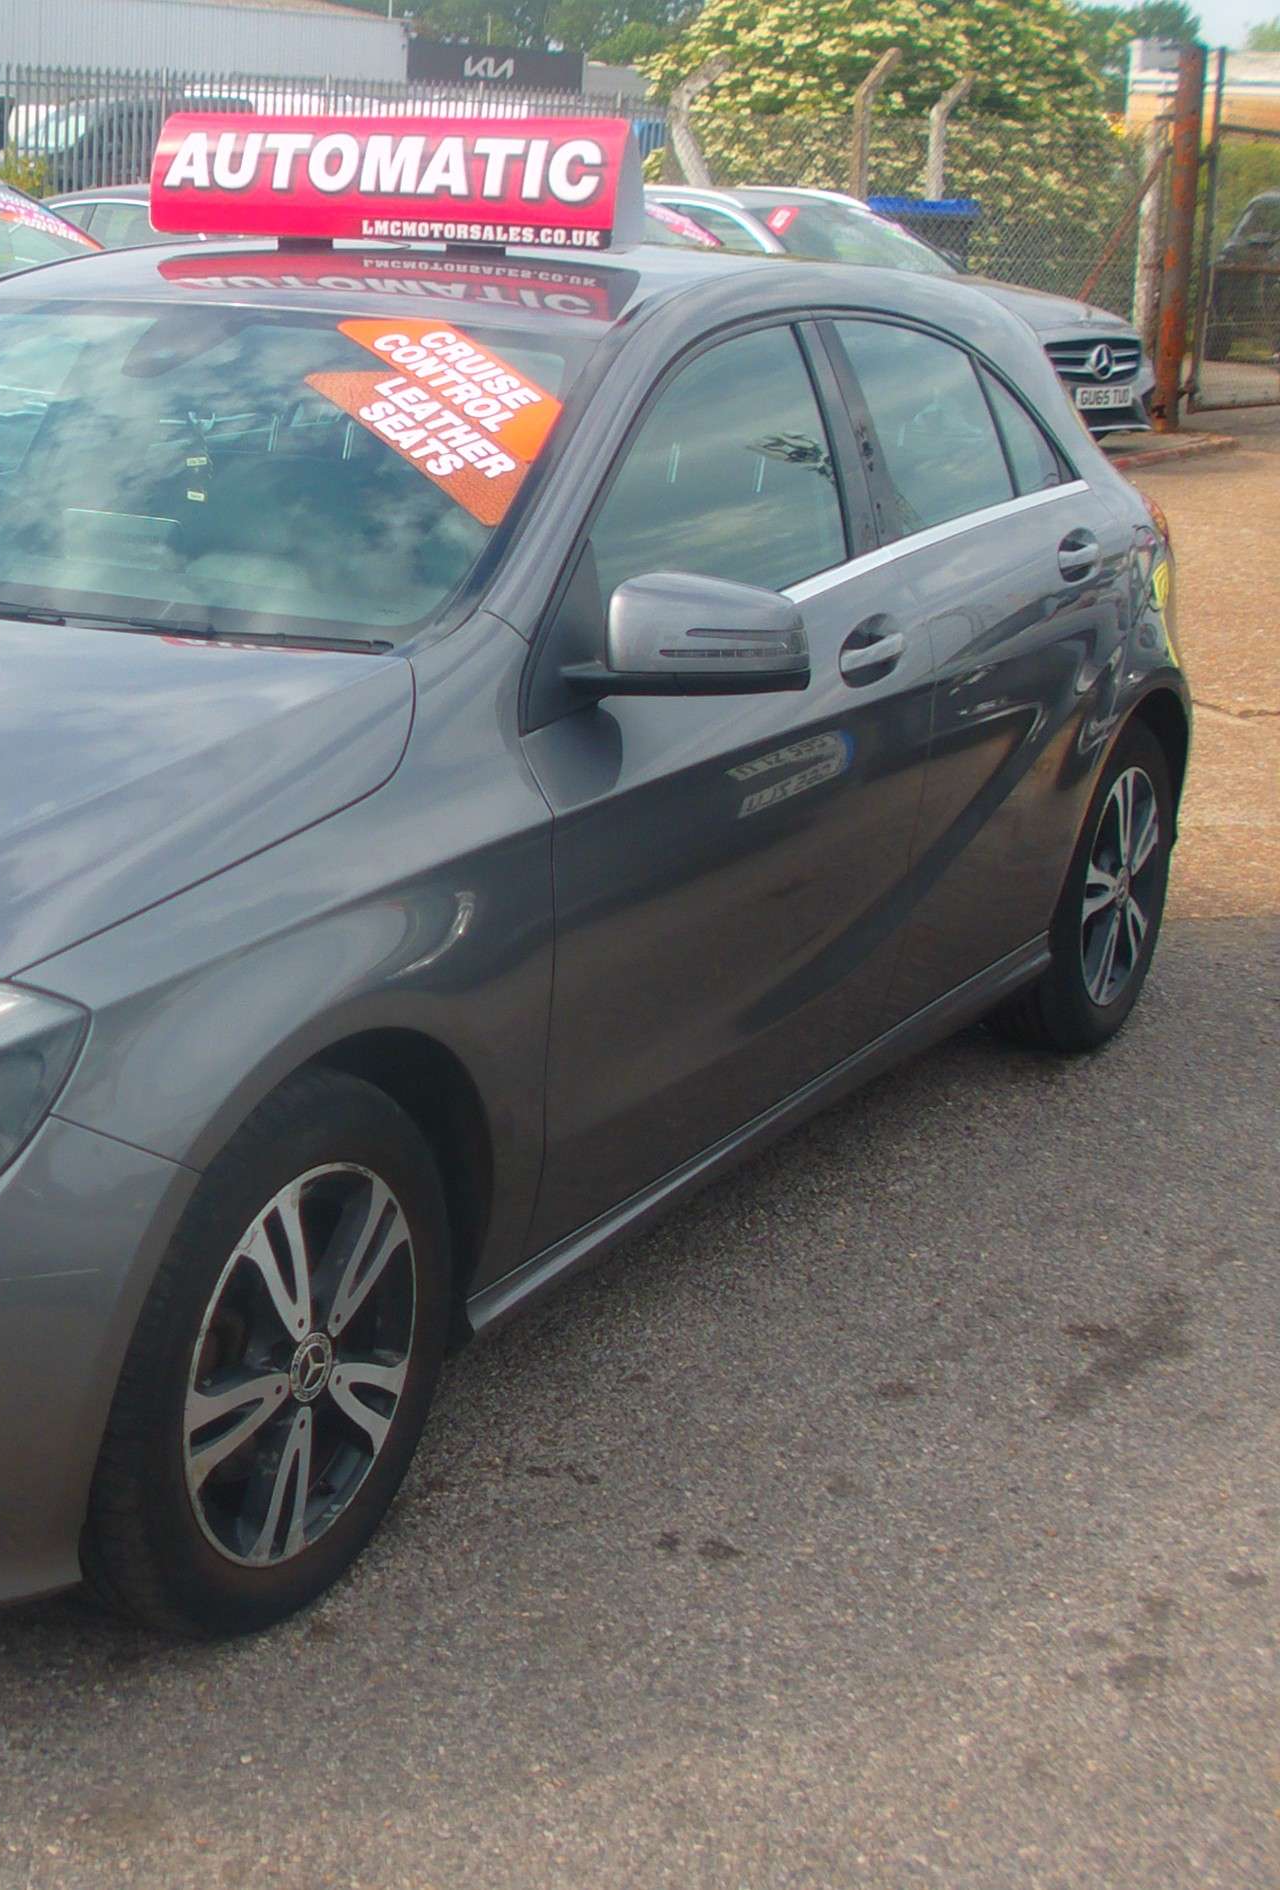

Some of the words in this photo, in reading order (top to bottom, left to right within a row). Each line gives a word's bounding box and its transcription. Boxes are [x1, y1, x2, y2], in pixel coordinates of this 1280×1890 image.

[464, 56, 515, 79] KIA
[163, 132, 604, 203] AUTOMATIC
[362, 219, 601, 247] LMCMOTORSALES.CO.UK
[373, 333, 515, 433] CONTROL
[421, 331, 542, 410] CRUISE
[359, 401, 464, 476] SEATS
[373, 376, 516, 479] LEATHER
